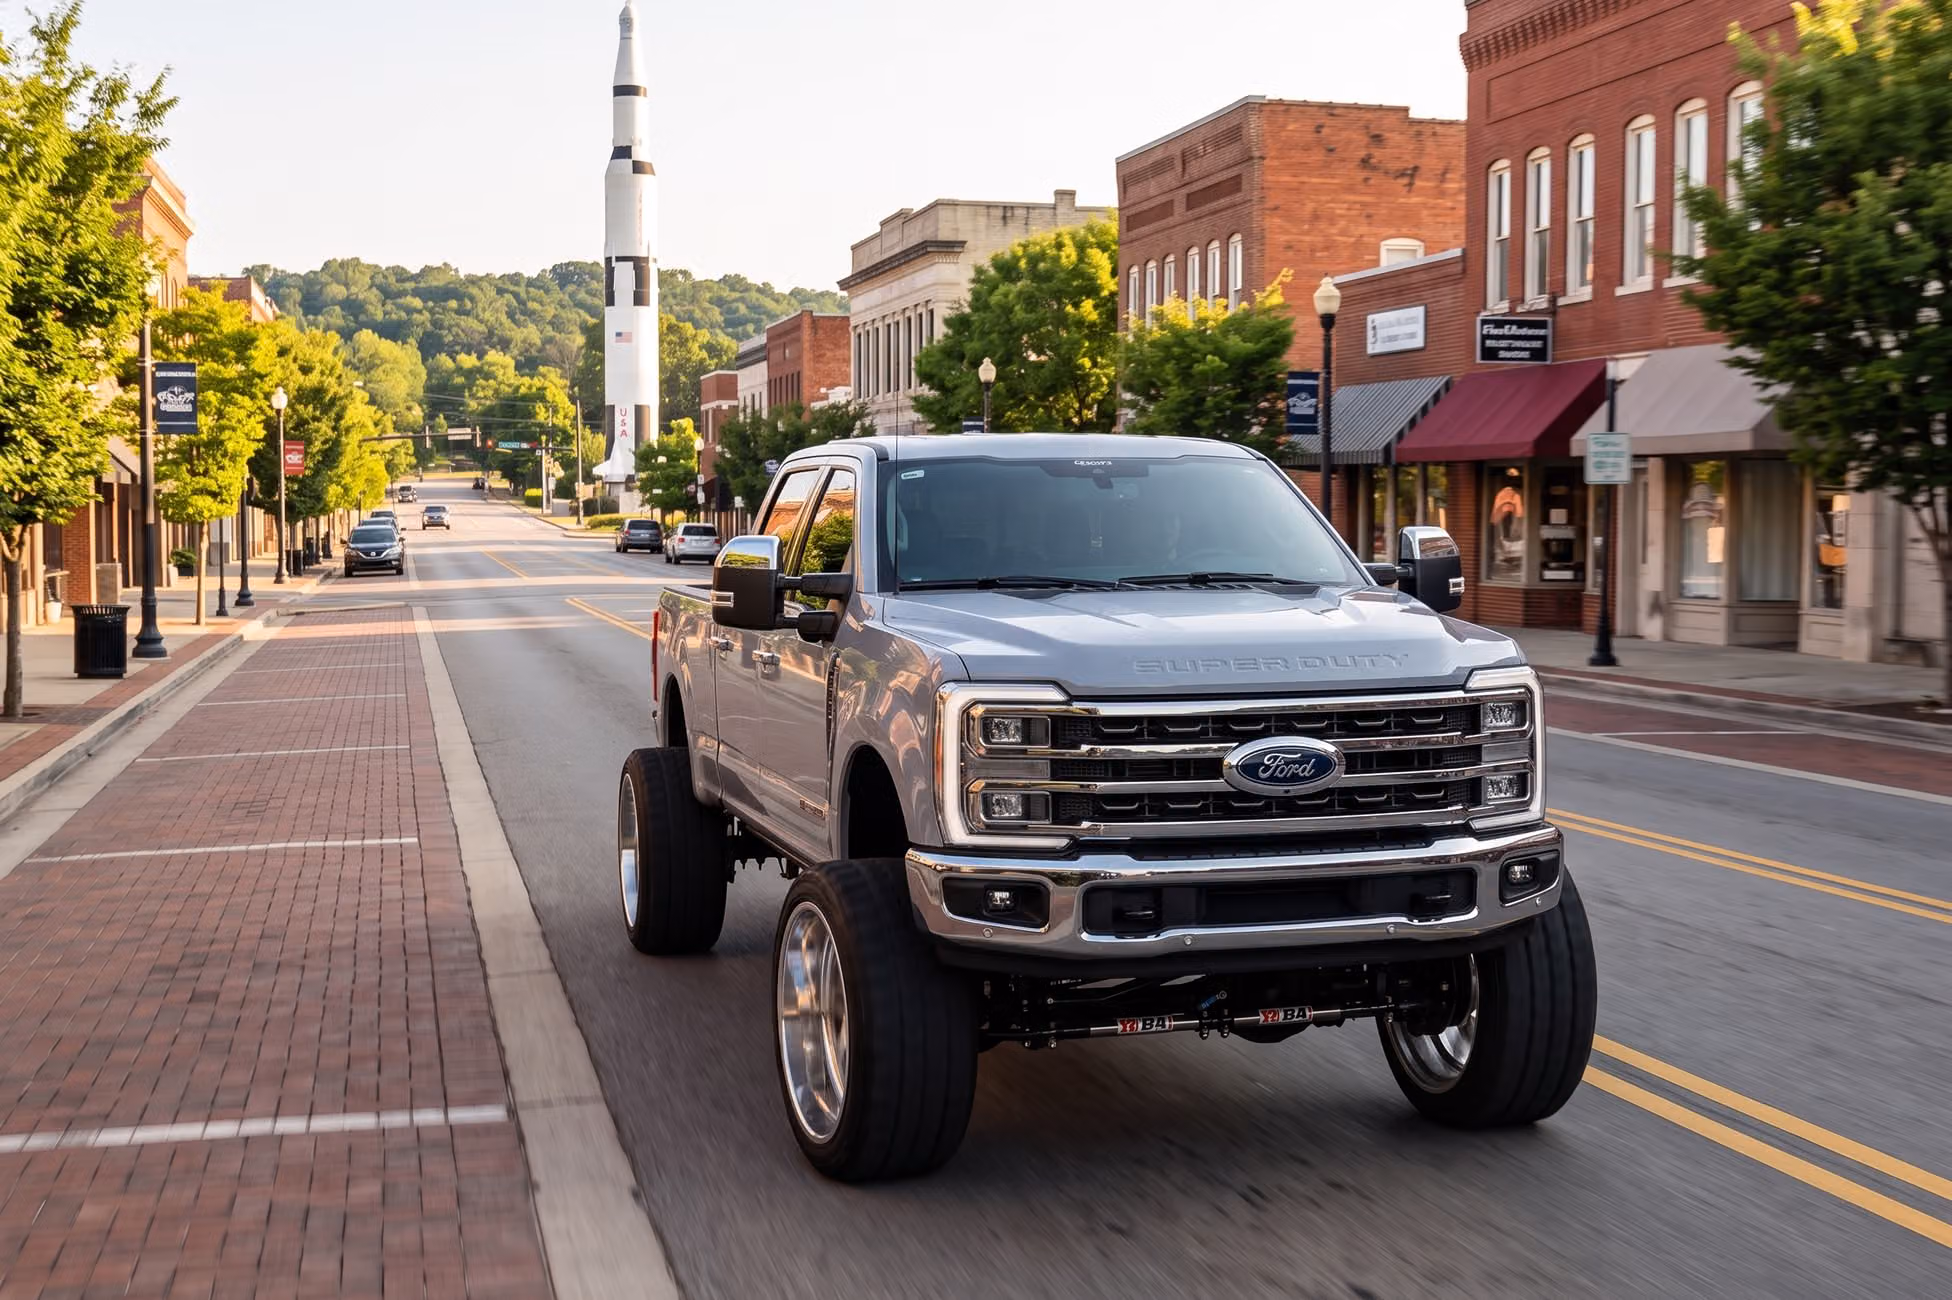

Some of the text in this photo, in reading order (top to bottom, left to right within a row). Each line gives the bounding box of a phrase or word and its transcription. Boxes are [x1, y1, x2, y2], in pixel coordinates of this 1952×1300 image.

[620, 408, 628, 438] USA
[1134, 654, 1409, 674] SUPER DUTY
[1258, 753, 1316, 779] Ford
